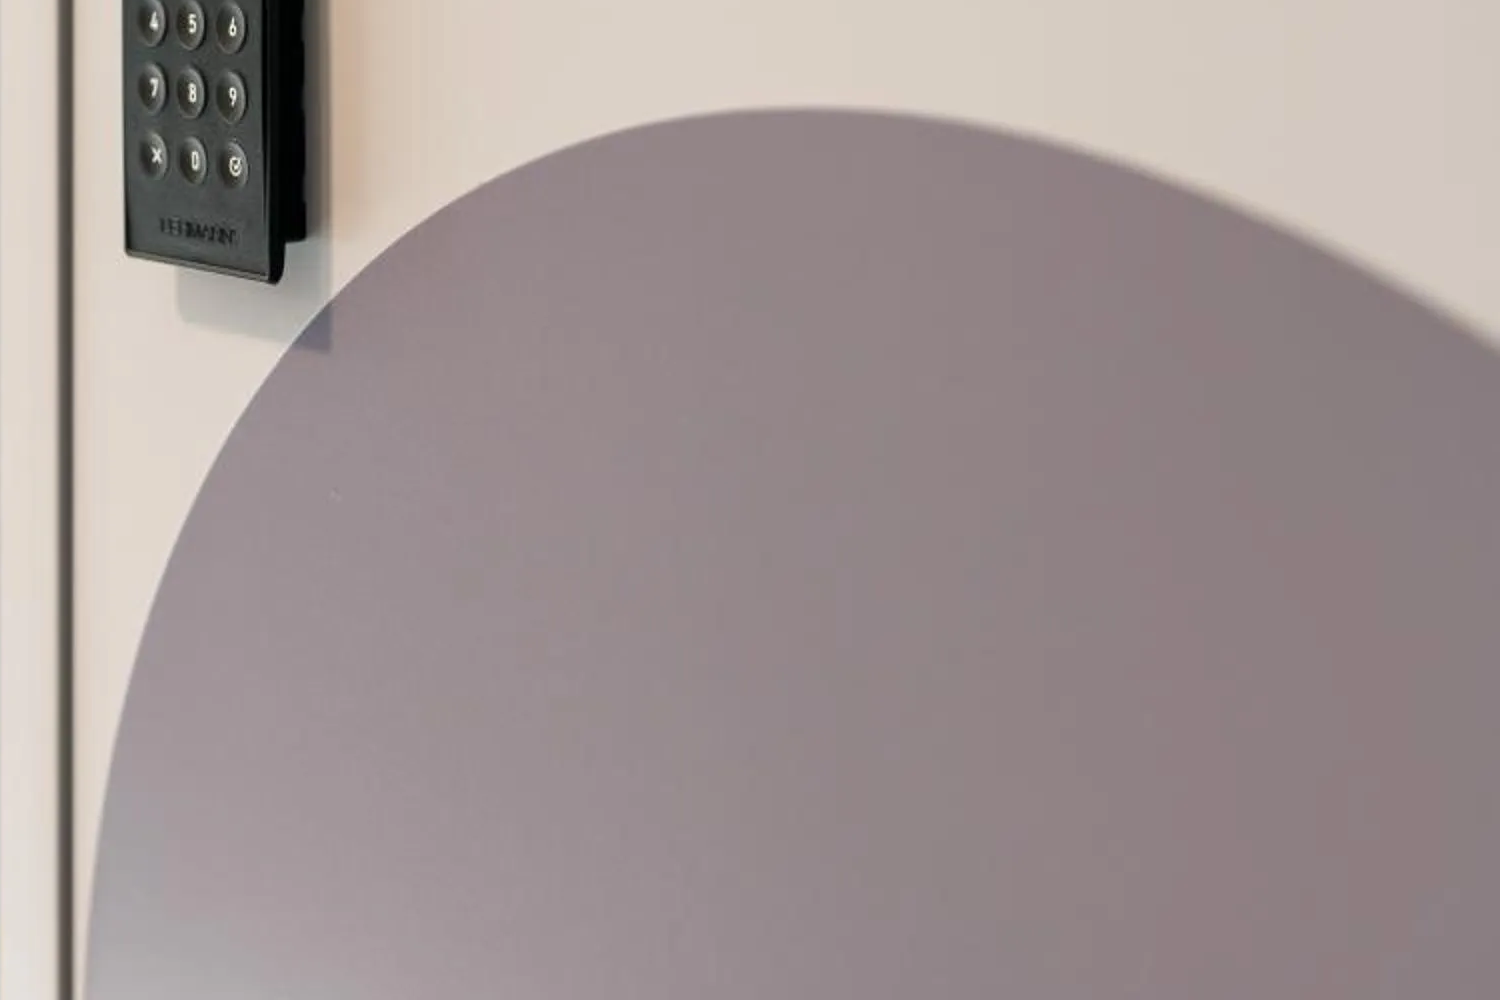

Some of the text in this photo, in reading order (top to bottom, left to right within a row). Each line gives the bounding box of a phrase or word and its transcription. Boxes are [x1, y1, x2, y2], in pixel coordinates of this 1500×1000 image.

[149, 11, 238, 37] 4 5 6
[149, 77, 238, 107] 7 8 9
[191, 150, 200, 171] 0
